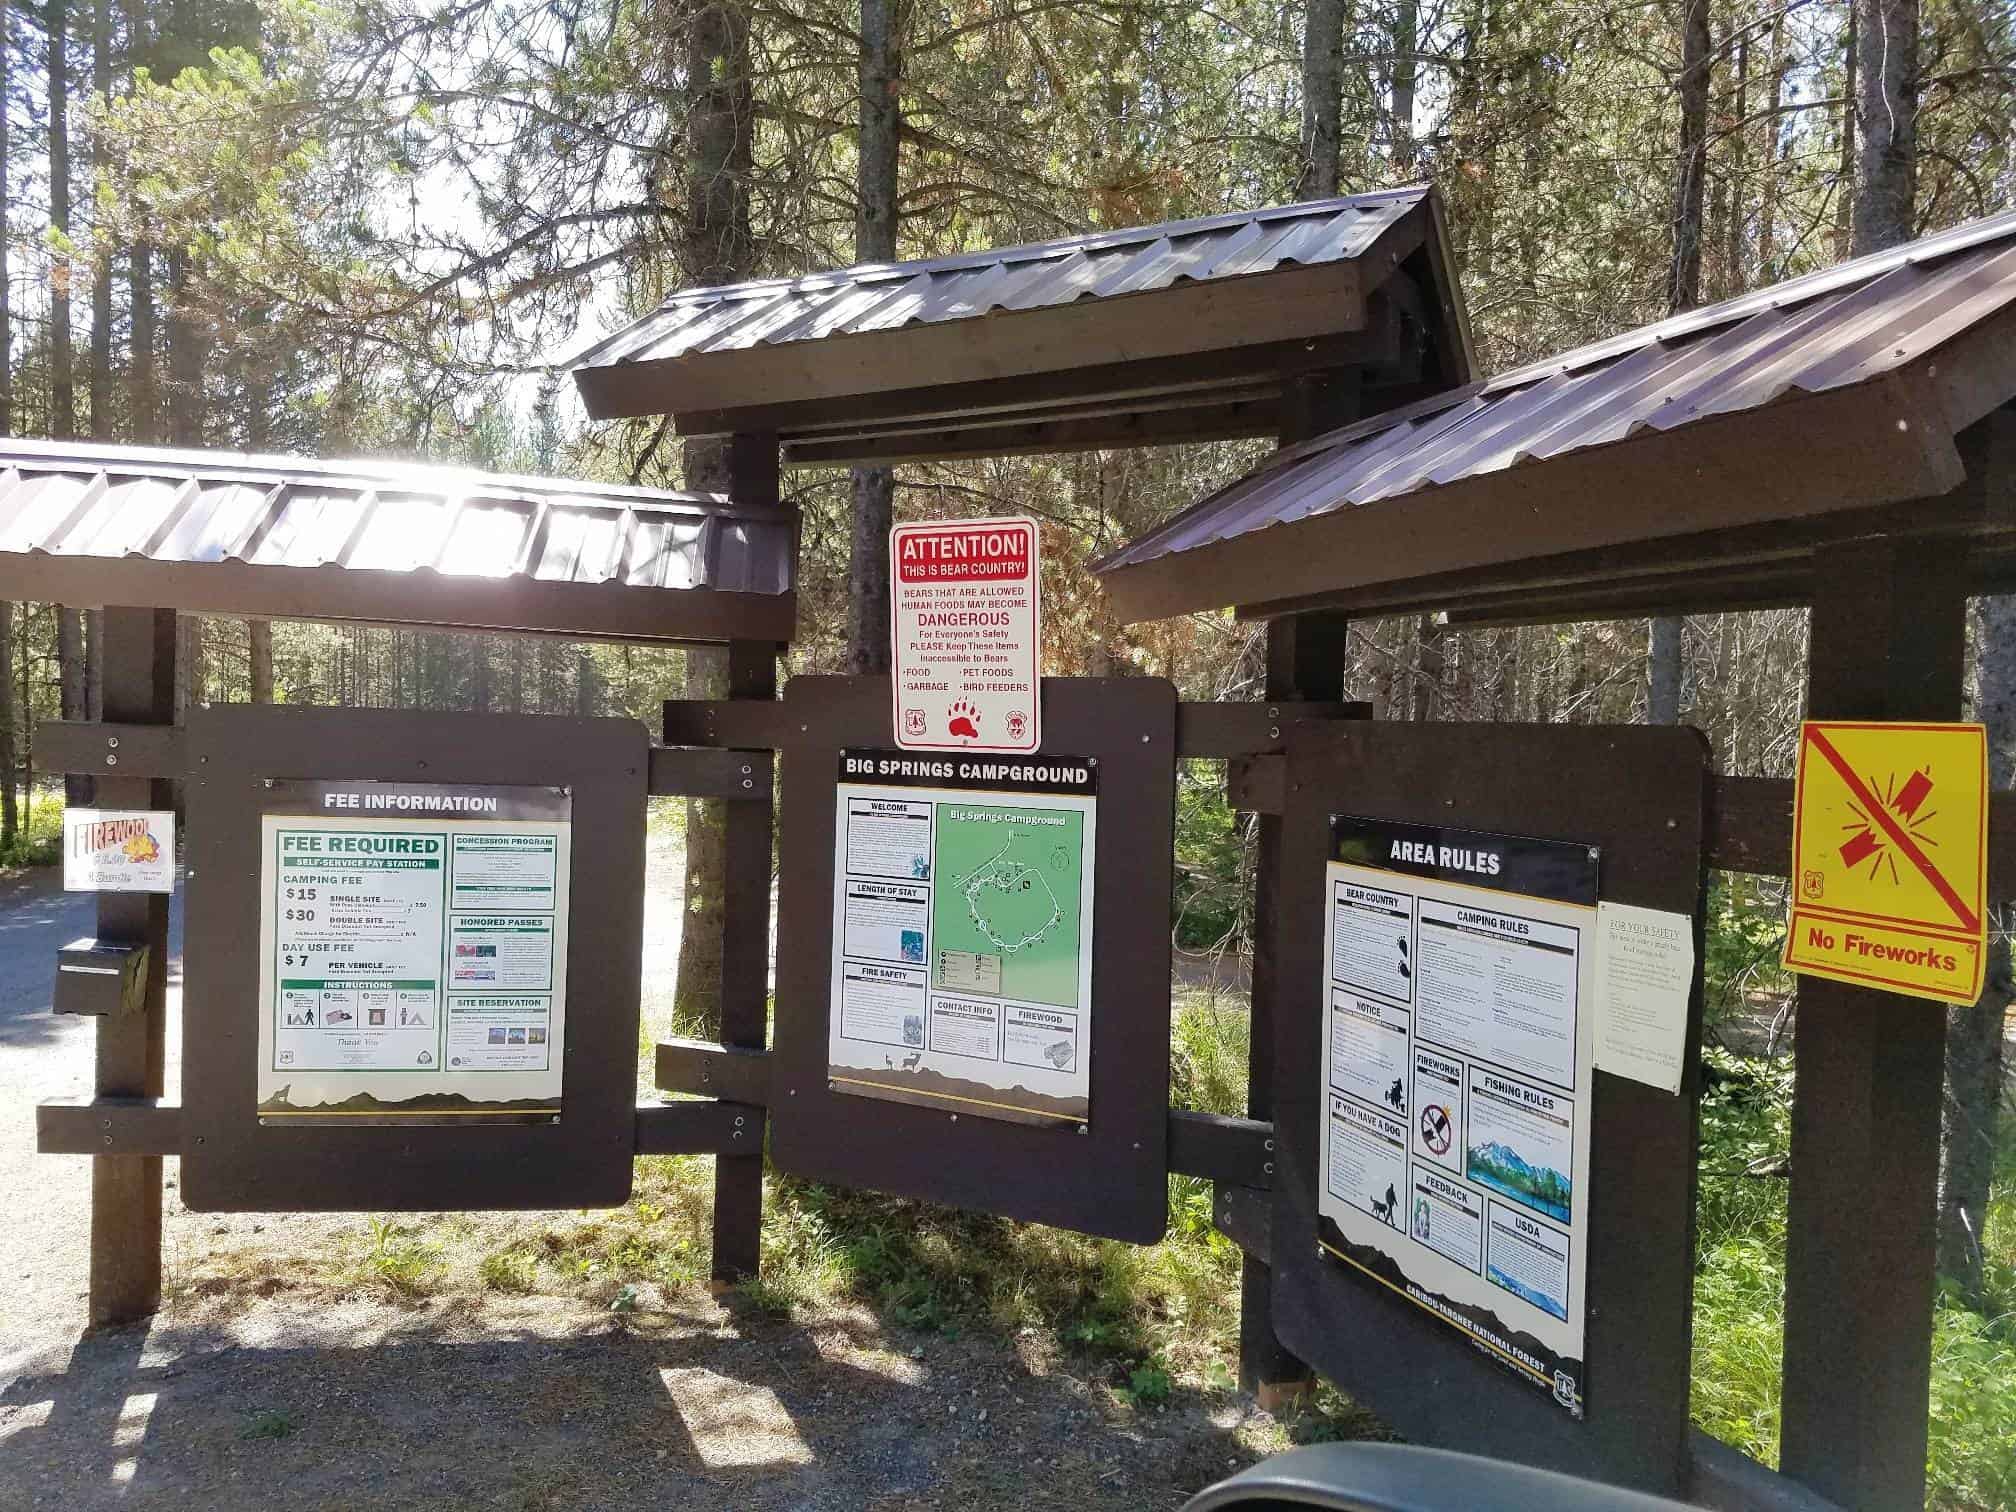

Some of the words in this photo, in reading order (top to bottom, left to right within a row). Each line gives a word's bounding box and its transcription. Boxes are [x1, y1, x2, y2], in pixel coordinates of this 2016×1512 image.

[904, 534, 1025, 559] ATTENTION!
[903, 565, 925, 577] THIS
[928, 564, 938, 576] IS
[940, 563, 968, 576] BEAR
[971, 561, 1025, 575] COUNTRY!
[904, 588, 933, 598] BEARS
[935, 588, 956, 597] THAT
[959, 587, 977, 597] ARE
[980, 586, 1024, 596] ALLOWED
[902, 601, 932, 611] HUMAN
[934, 600, 965, 610] FOODS
[967, 600, 985, 609] MAY
[988, 599, 1028, 609] BECOME
[918, 612, 1010, 627] DANGEROUS
[919, 630, 932, 639] For
[935, 630, 980, 640] Everyone's
[982, 629, 1009, 639] Safety
[910, 642, 944, 651] PLEASE
[946, 642, 967, 652] Keep
[967, 641, 994, 650] These
[995, 641, 1019, 650] Items
[920, 654, 972, 663] Inaccessible
[973, 654, 982, 663] to
[984, 654, 1008, 663] Bears
[906, 668, 931, 677] FOOD
[963, 668, 980, 677] PET
[982, 668, 1014, 677] FOODS
[907, 682, 949, 691] GARBAGE
[963, 683, 984, 692] BIRD
[986, 683, 1029, 692] FEEDERS
[846, 758, 874, 774] BIG
[879, 759, 954, 779] SPRINGS
[959, 763, 1089, 784] CAMPGROUND
[324, 793, 360, 809] FEE
[364, 794, 497, 812] INFORMATION
[871, 802, 908, 812] WELCOME
[950, 809, 967, 821] Big
[967, 811, 1002, 824] Springs
[1005, 813, 1066, 826] Campground
[283, 836, 322, 852] FEE
[328, 837, 439, 854] REQUIRED
[456, 837, 510, 845] CONCESSION
[511, 838, 553, 846] PROGRAM
[296, 858, 364, 868] SELF-SERVICE
[366, 859, 384, 868] PAY
[386, 859, 426, 869] STATION
[1390, 839, 1436, 866] AREA
[1439, 847, 1500, 875] RULES
[283, 875, 338, 885] CAMPING
[341, 876, 363, 886] FEE
[857, 884, 886, 894] LENGTH
[887, 887, 897, 895] OF
[898, 888, 918, 897] STAY
[329, 895, 361, 903] SINGLE
[363, 896, 381, 904] SITE
[1346, 888, 1365, 900] BEAR
[1365, 892, 1399, 908] COUNTRY
[329, 917, 363, 925] DOUBLE
[460, 917, 506, 926] HONORED
[508, 918, 543, 927] PASSES
[1457, 911, 1497, 928] CAMPING
[1499, 919, 1529, 935] RULES
[282, 943, 305, 952] DAY
[308, 943, 331, 952] USE
[333, 944, 355, 952] FEE
[1808, 927, 1835, 950] No
[1844, 933, 1957, 972] Fireworks
[862, 967, 879, 977] FIRE
[879, 969, 907, 980] SAFETY
[323, 981, 393, 989] INSTRUCTIONS
[456, 999, 477, 1007] SITE
[478, 999, 542, 1007] RESERVATION
[937, 1001, 972, 1013] CONTACT
[974, 1005, 993, 1016] INFO
[1356, 1001, 1381, 1017] NOTICE
[1018, 1010, 1063, 1024] FIREWOOD
[1417, 1054, 1460, 1077] FIREWORKS
[1484, 1076, 1521, 1098] FISHING
[1523, 1090, 1554, 1110] RULES
[1335, 1101, 1342, 1111] IF
[1343, 1103, 1357, 1118] YOU
[1357, 1108, 1377, 1127] HAVE
[1378, 1117, 1384, 1130] A
[1384, 1122, 1401, 1138] DOG
[1425, 1175, 1468, 1204] FEEDBACK
[1515, 1216, 1541, 1239] USDA
[1406, 1284, 1473, 1331] CARIBOU-TARGHEE
[1472, 1323, 1512, 1354] NATIONAL
[1512, 1347, 1545, 1372] FOREST
